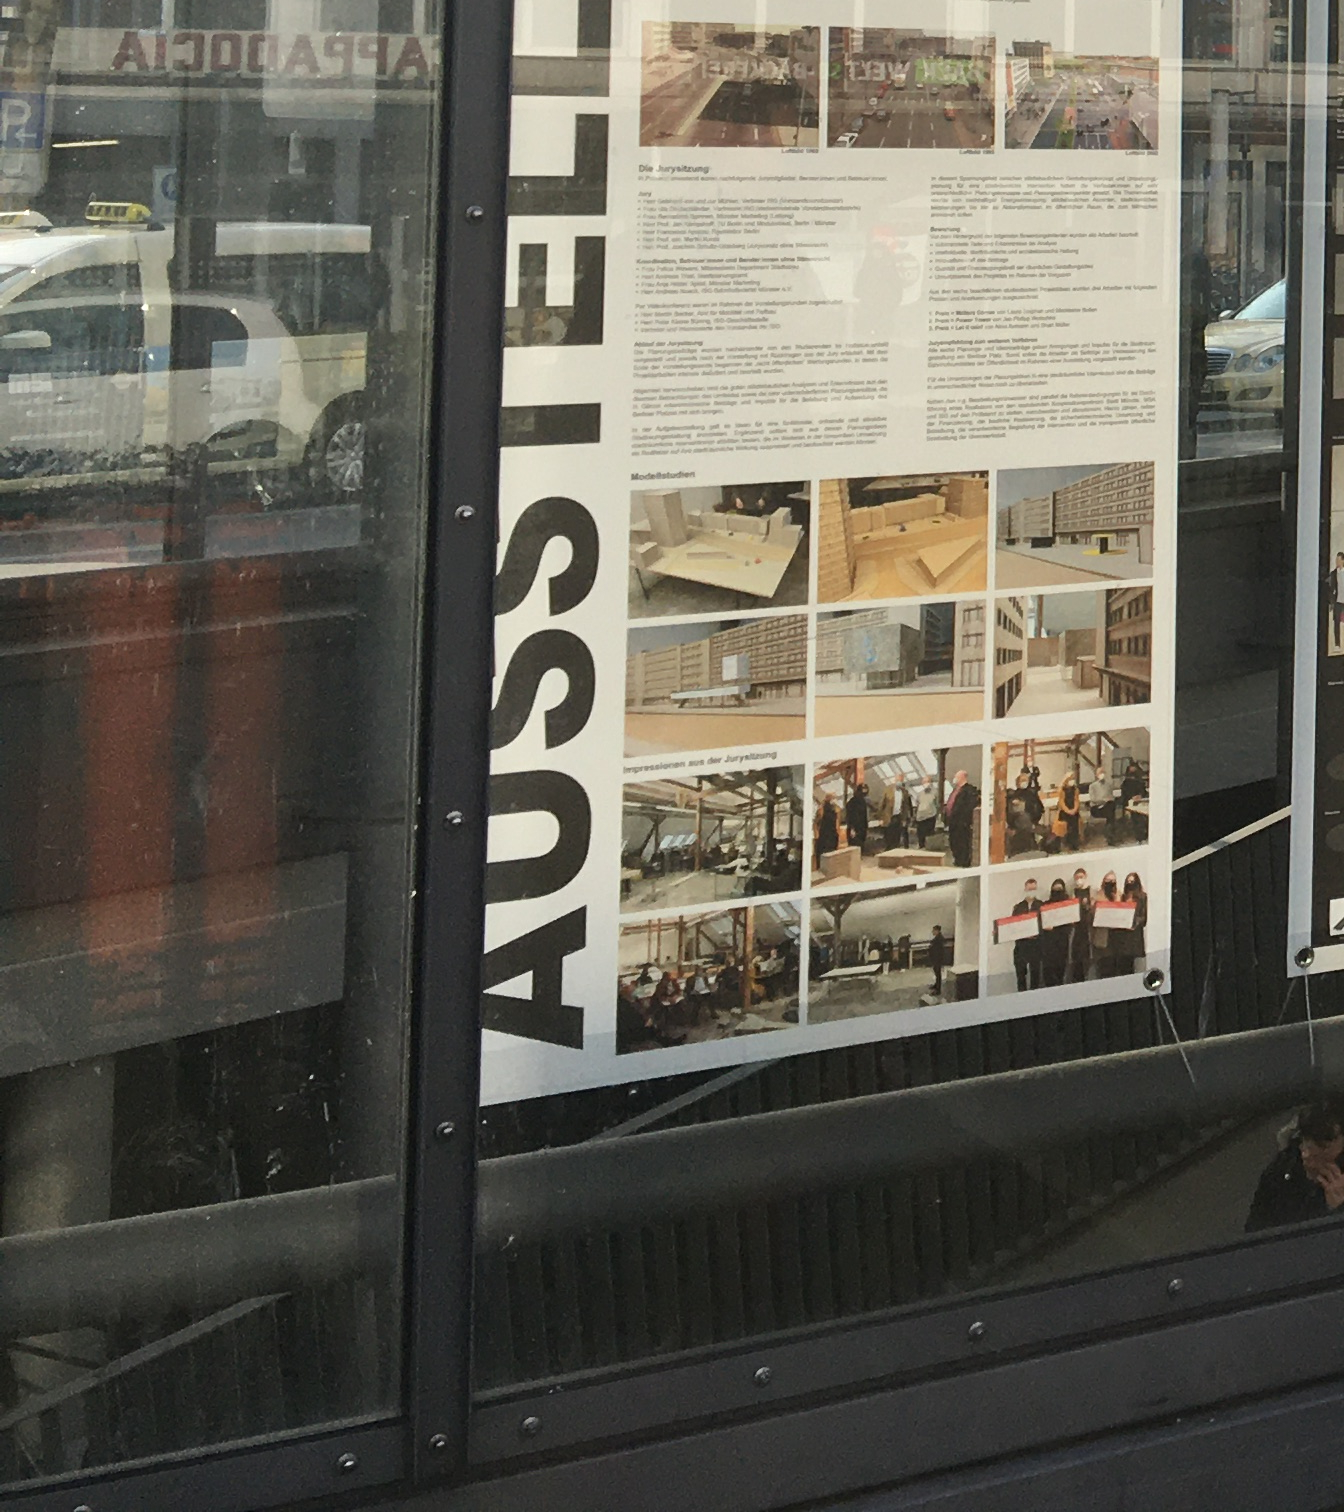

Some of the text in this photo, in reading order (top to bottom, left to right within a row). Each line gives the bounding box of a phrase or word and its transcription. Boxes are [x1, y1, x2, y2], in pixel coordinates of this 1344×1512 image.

[0, 98, 33, 141] P
[638, 164, 654, 174] Die
[623, 751, 778, 775] Impressionen aus der Jurysitzung
